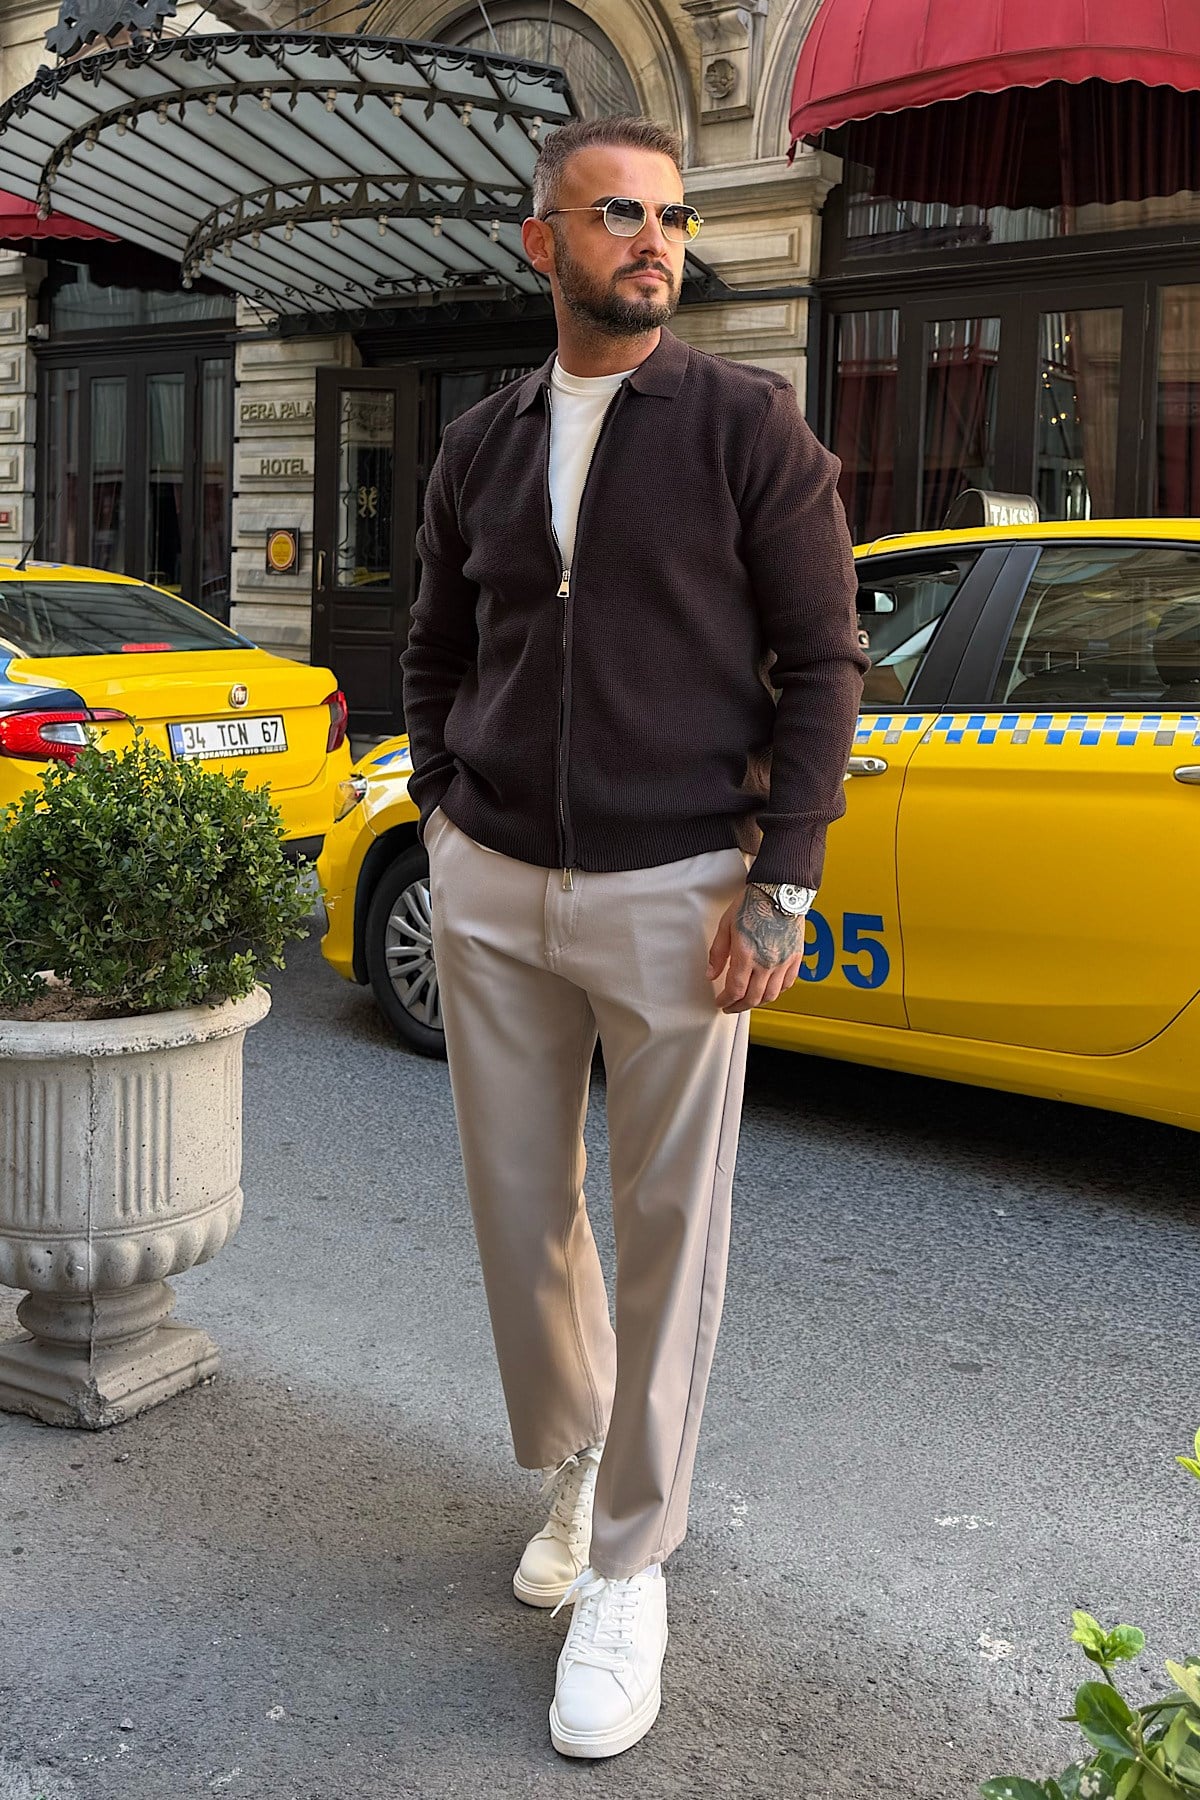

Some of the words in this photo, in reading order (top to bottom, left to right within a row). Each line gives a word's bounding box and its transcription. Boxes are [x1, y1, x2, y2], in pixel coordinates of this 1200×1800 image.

[241, 403, 277, 420] PERA
[260, 458, 309, 475] HOTEL
[184, 727, 206, 749] 34
[217, 723, 248, 747] TCN
[261, 721, 279, 743] 67
